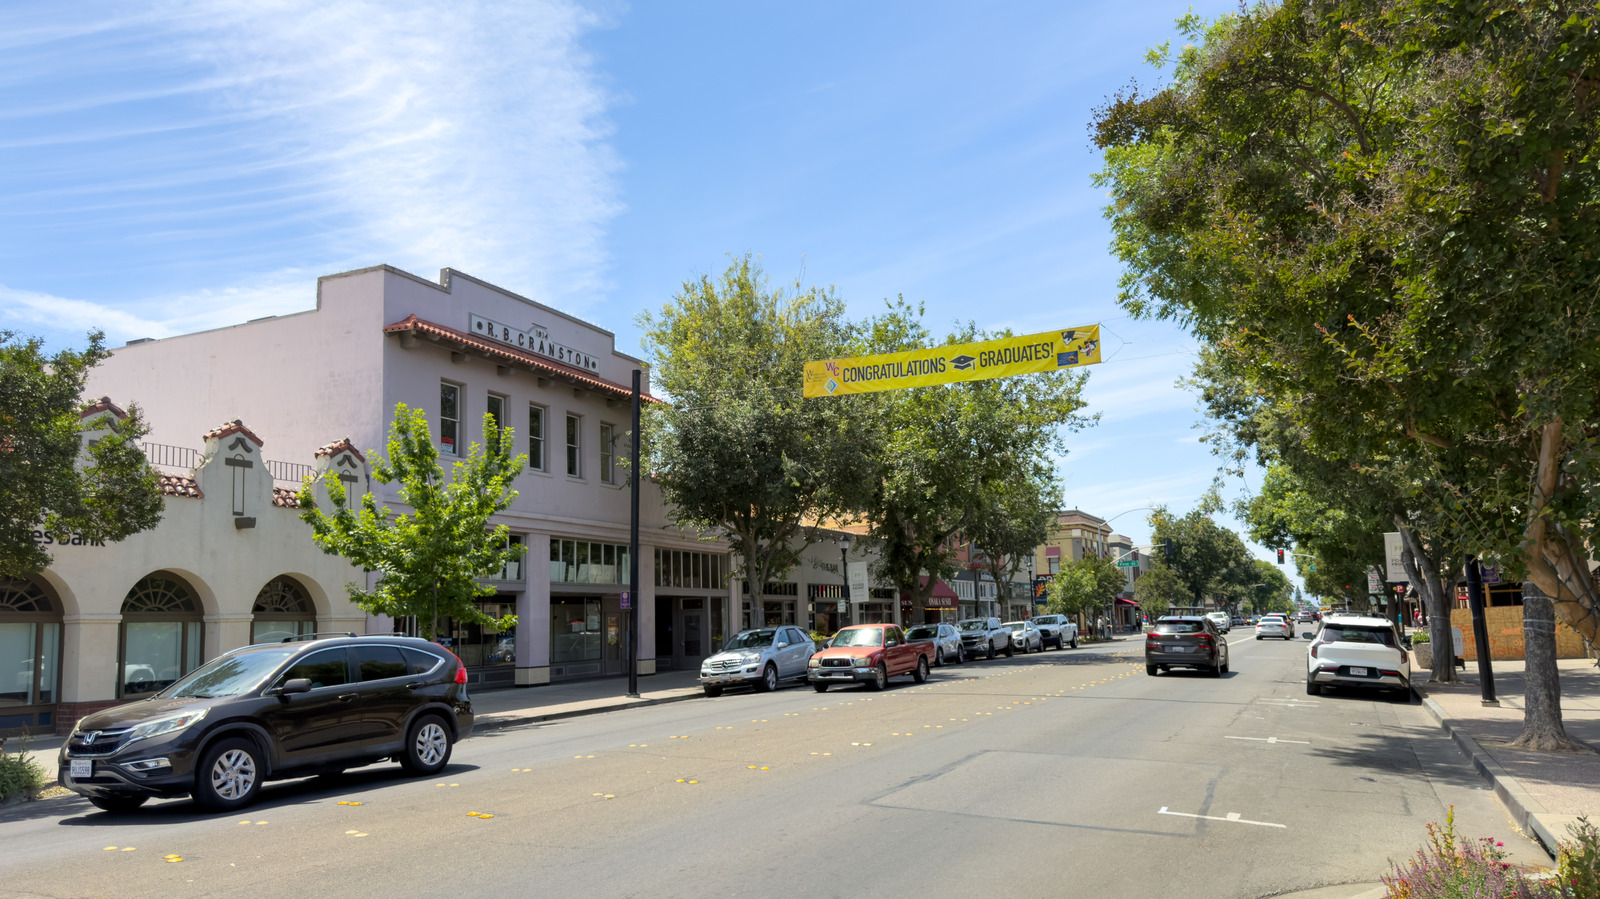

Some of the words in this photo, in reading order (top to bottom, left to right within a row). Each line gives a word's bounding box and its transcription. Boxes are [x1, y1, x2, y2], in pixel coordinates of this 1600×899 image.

[518, 333, 590, 368] CRANSTON
[842, 357, 947, 383] CONGRATULATIONS
[979, 341, 1055, 368] GRADUATES!
